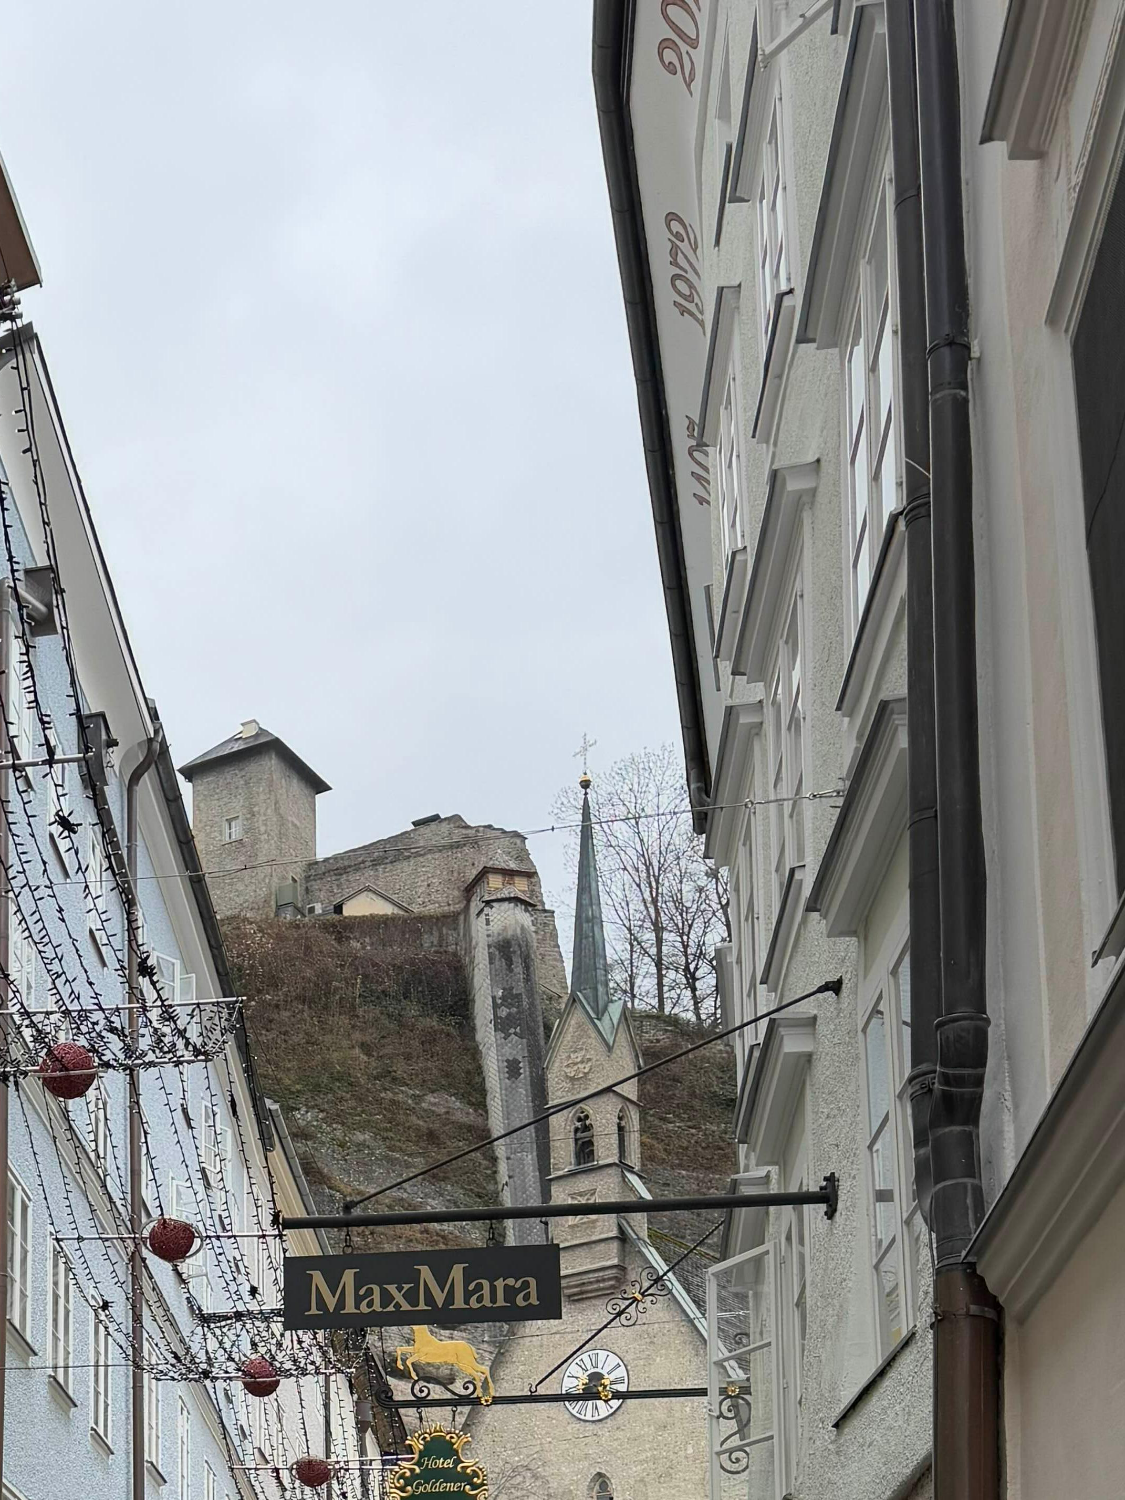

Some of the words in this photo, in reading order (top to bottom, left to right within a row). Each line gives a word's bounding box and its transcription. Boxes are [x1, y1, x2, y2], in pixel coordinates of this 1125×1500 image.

[664, 211, 706, 338] 1972
[304, 1263, 540, 1316] MaxMara
[420, 1456, 457, 1470] Hotel
[412, 1479, 467, 1495] Goldener
